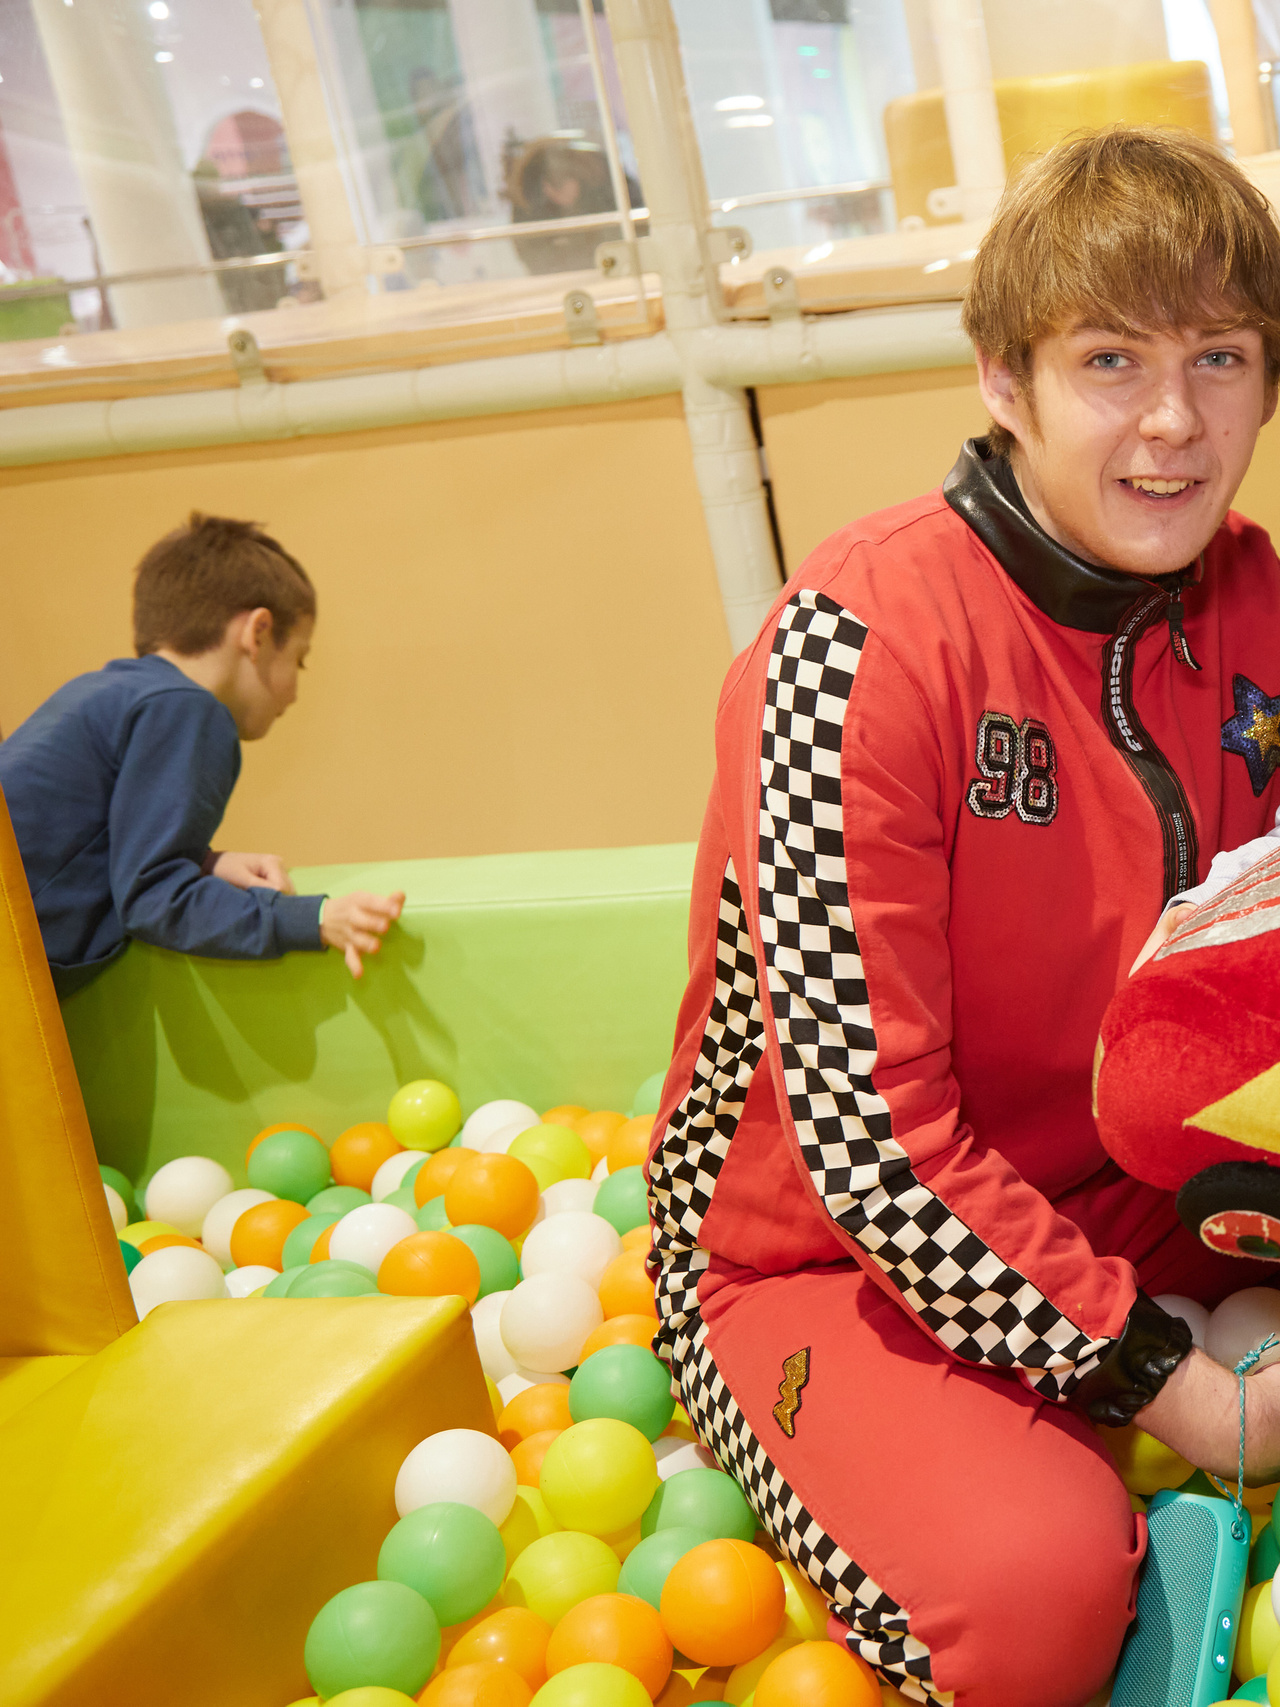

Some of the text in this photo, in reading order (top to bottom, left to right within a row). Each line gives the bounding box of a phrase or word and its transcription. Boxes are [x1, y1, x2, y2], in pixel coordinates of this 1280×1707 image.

[1110, 635, 1143, 752] FASHION
[1172, 630, 1185, 660] CLASSIC
[965, 709, 1059, 826] 98
